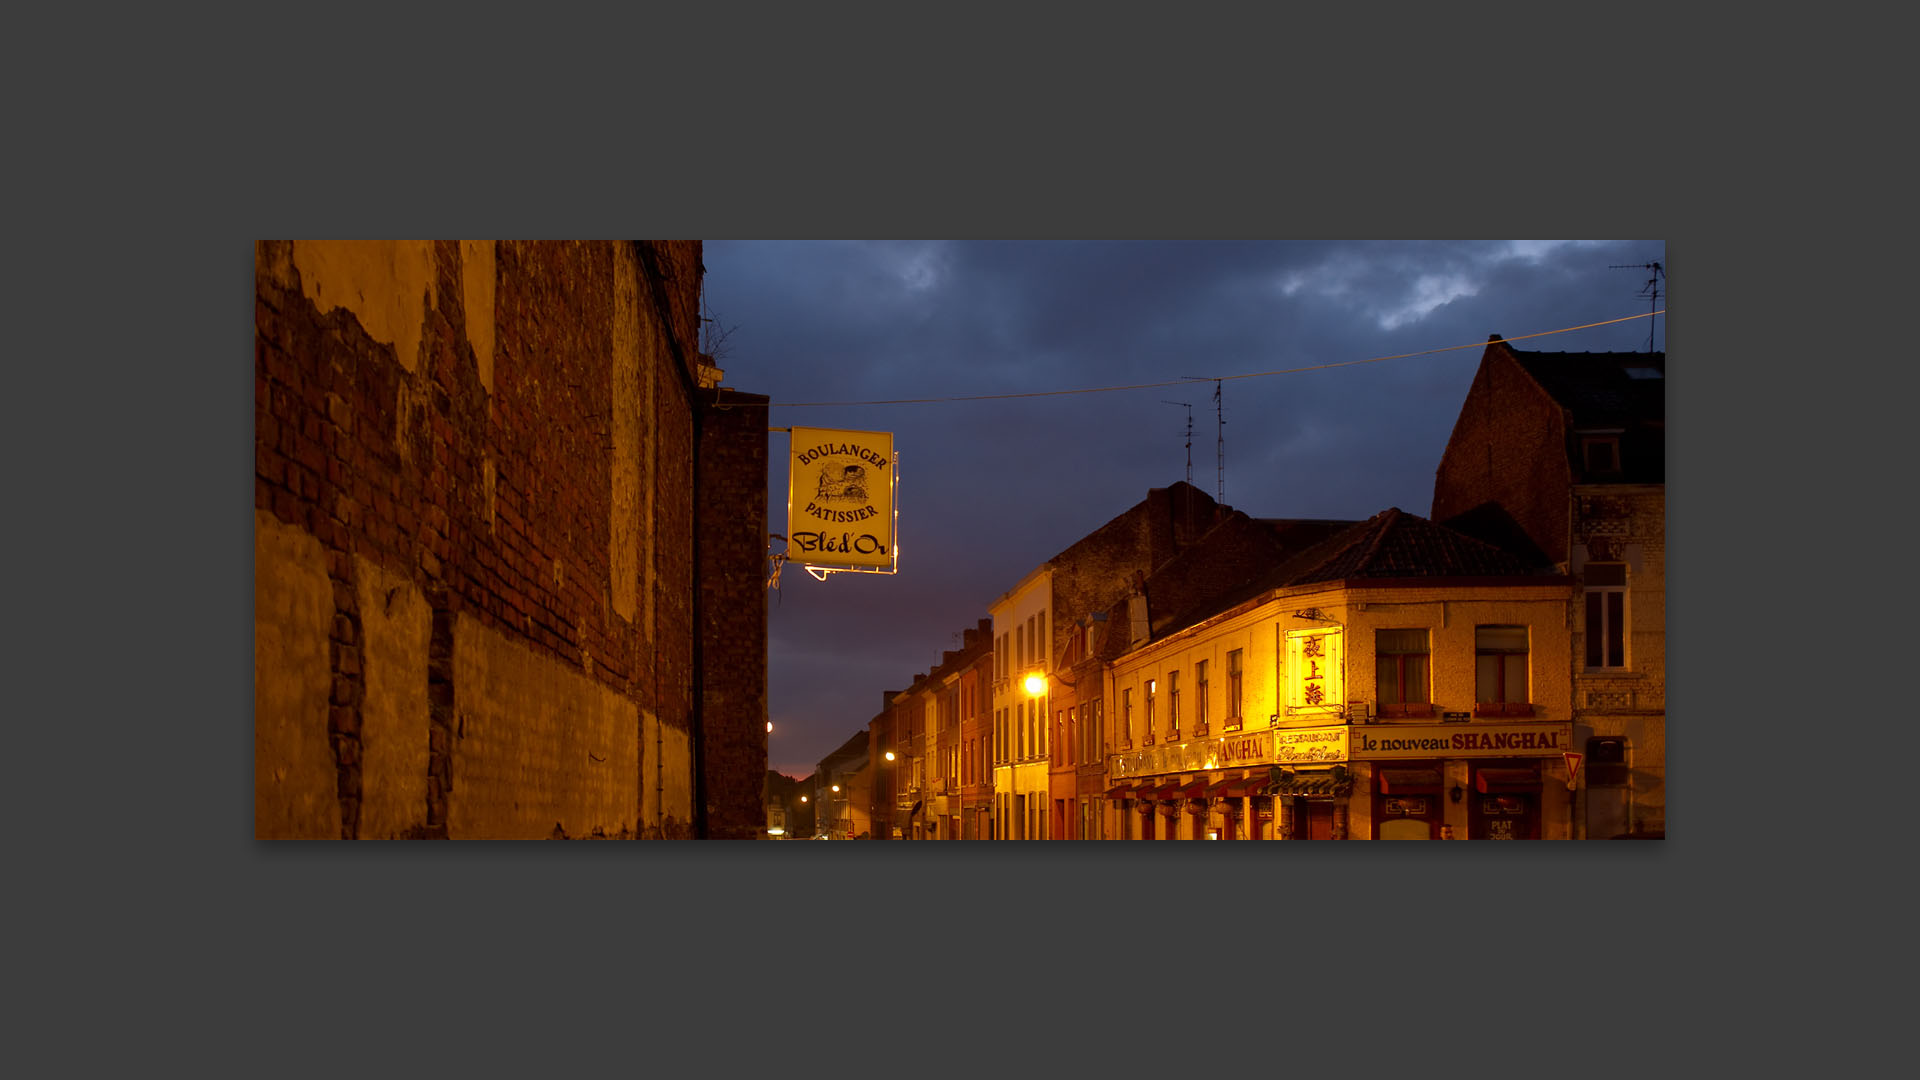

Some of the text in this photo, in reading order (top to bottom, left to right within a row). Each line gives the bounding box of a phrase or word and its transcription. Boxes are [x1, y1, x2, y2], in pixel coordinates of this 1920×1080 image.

[798, 443, 887, 470] BOULANGER
[805, 502, 878, 523] PATISSIER
[1362, 732, 1559, 751] le nouveau SHANGHAI
[1491, 820, 1512, 830] PLAT
